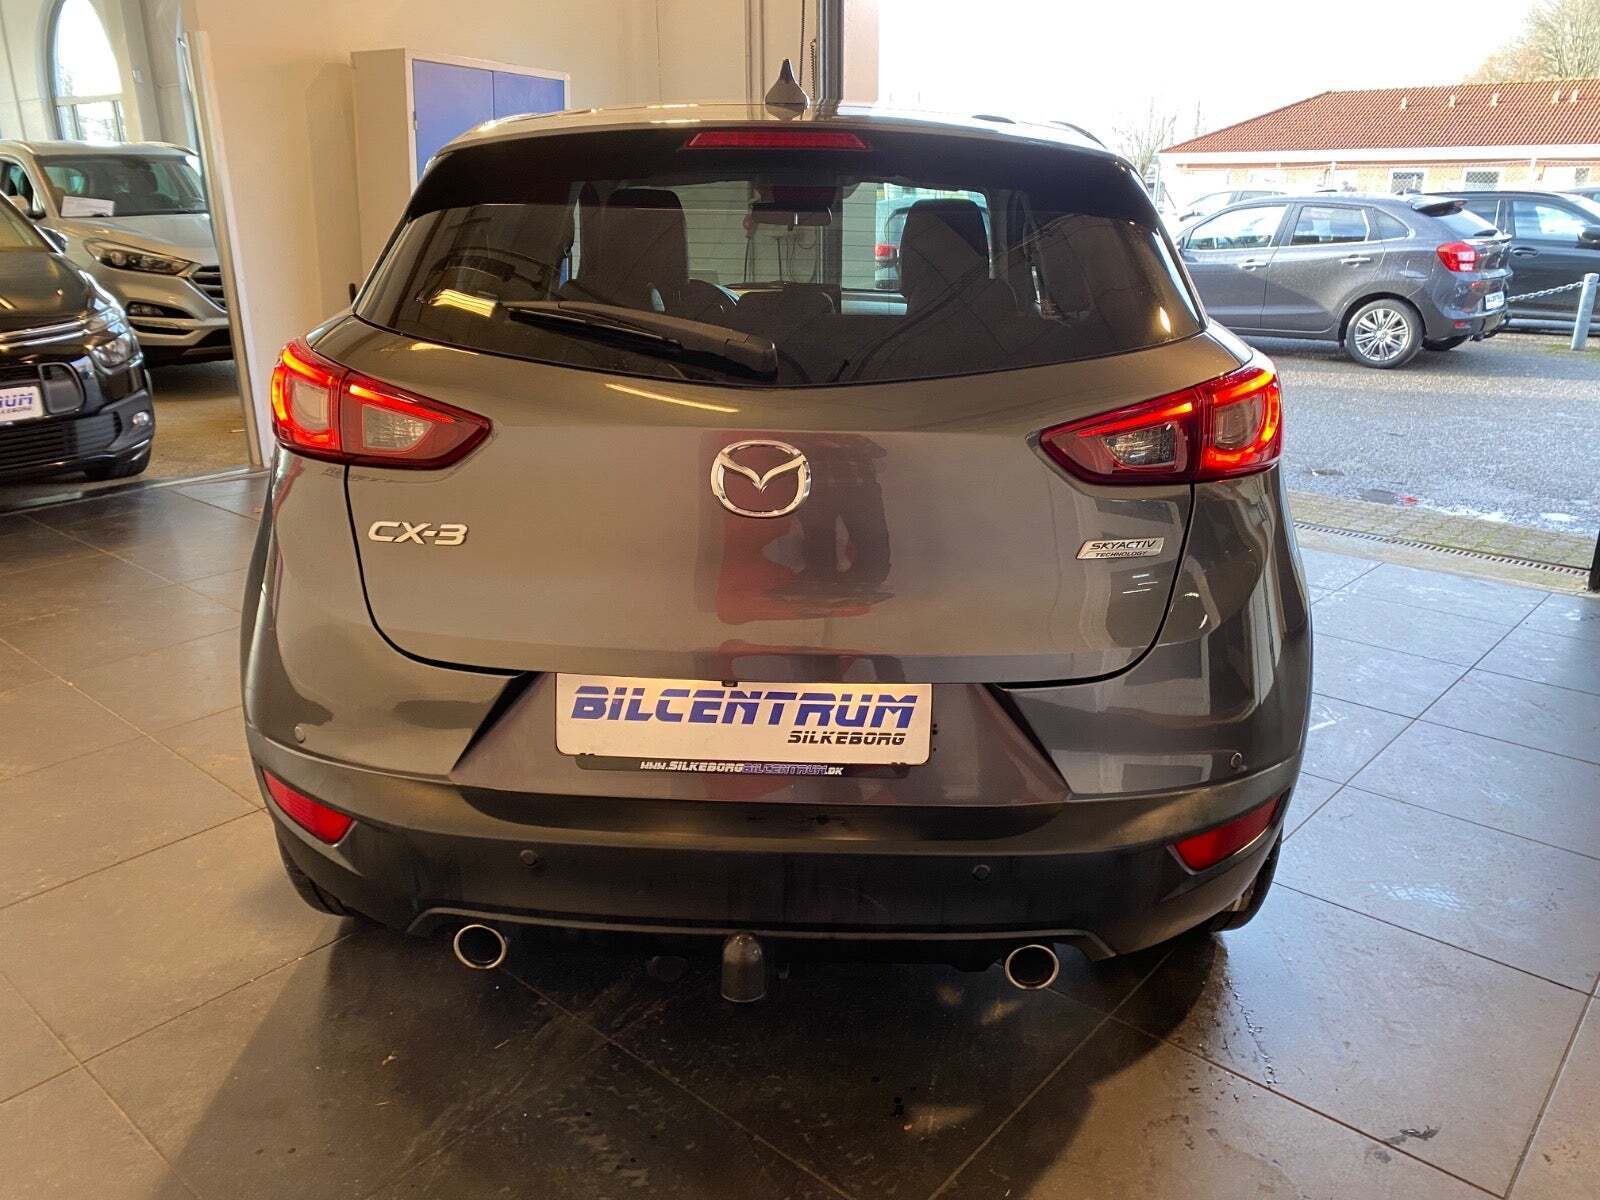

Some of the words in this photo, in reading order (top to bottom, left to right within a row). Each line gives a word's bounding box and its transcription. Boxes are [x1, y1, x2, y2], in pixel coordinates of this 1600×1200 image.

[368, 520, 468, 546] CX-3
[1090, 540, 1156, 551] SKYACTIV
[571, 685, 918, 729] BILCENTRUM
[787, 730, 907, 746] SILKEBORG
